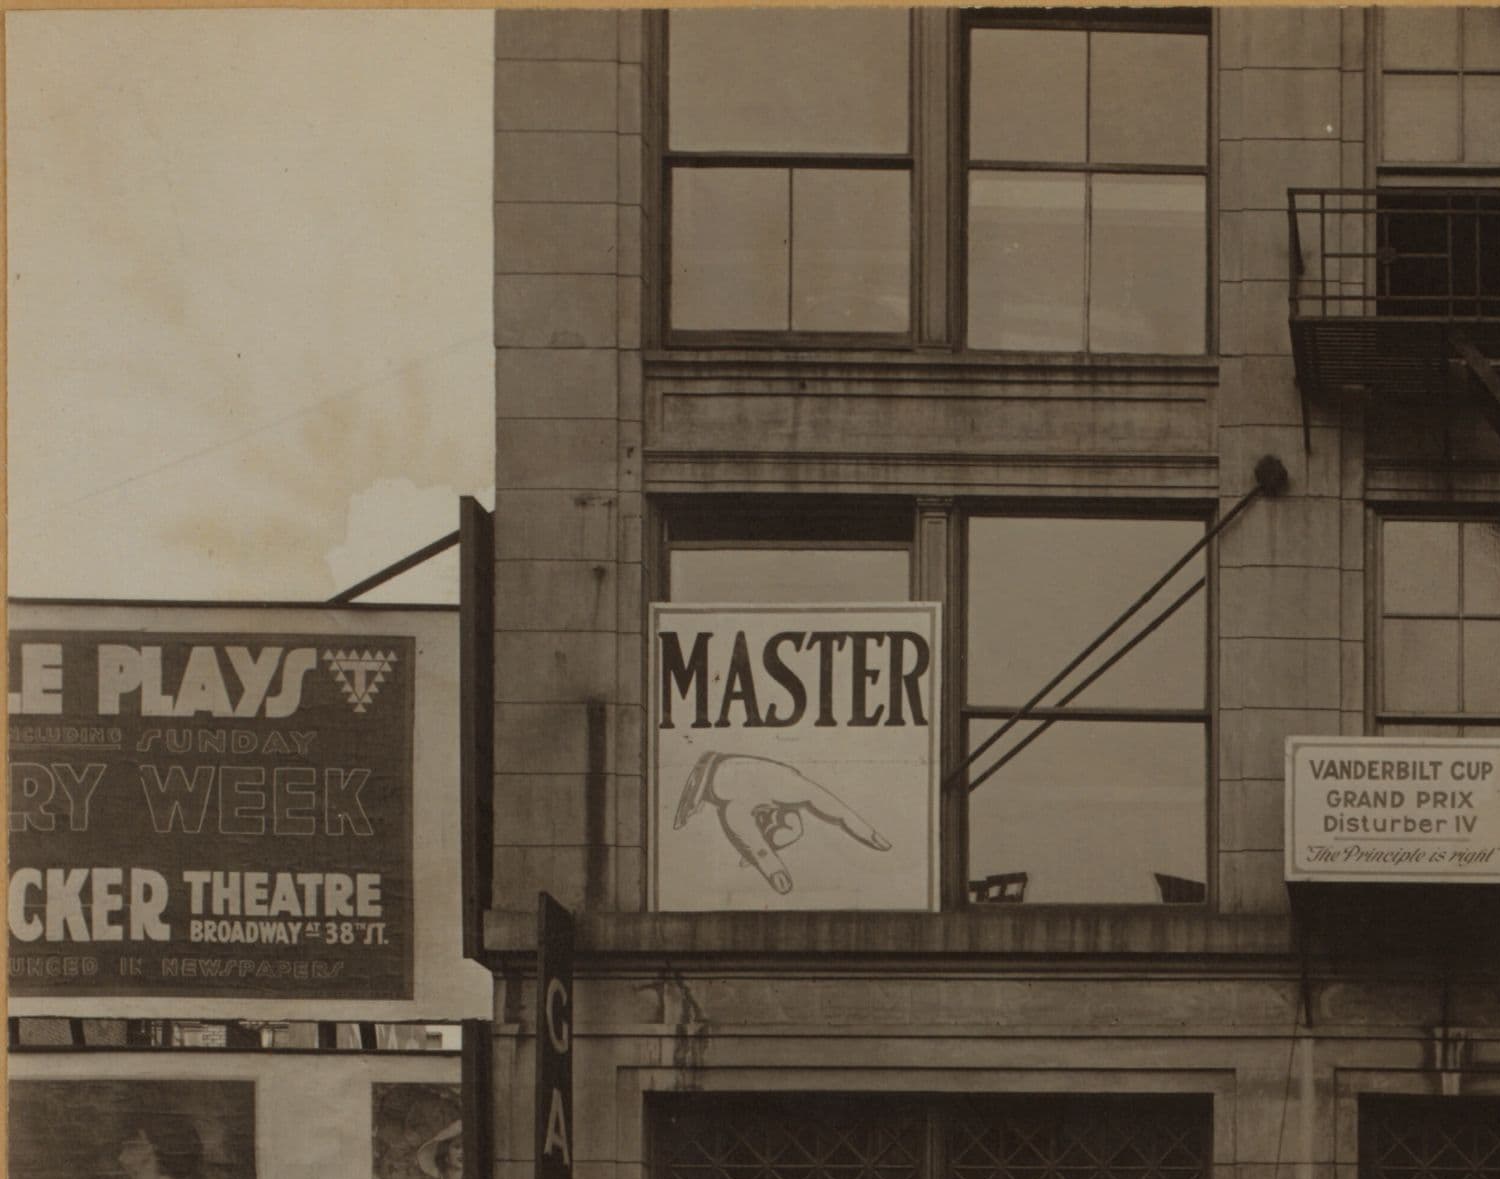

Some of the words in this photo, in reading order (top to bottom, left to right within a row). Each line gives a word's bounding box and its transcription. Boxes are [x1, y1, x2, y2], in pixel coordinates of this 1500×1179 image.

[98, 643, 316, 719] PLAYS
[658, 630, 931, 729] MASTER
[136, 729, 317, 753] SUNDAY
[1309, 759, 1443, 781] VANDERBILT
[1450, 760, 1494, 781] CUP
[139, 764, 374, 836] WEEK
[1326, 790, 1405, 809] GRAND
[1416, 791, 1474, 809] PRIX
[1323, 813, 1448, 833] Disturber
[1455, 815, 1478, 832] IV
[1342, 845, 1426, 865] Principle
[1428, 849, 1446, 862] is
[183, 870, 383, 918] THEATRE
[190, 920, 302, 945] BROADWAY
[304, 921, 321, 937] AT
[161, 957, 346, 980] NEWSPAPERS
